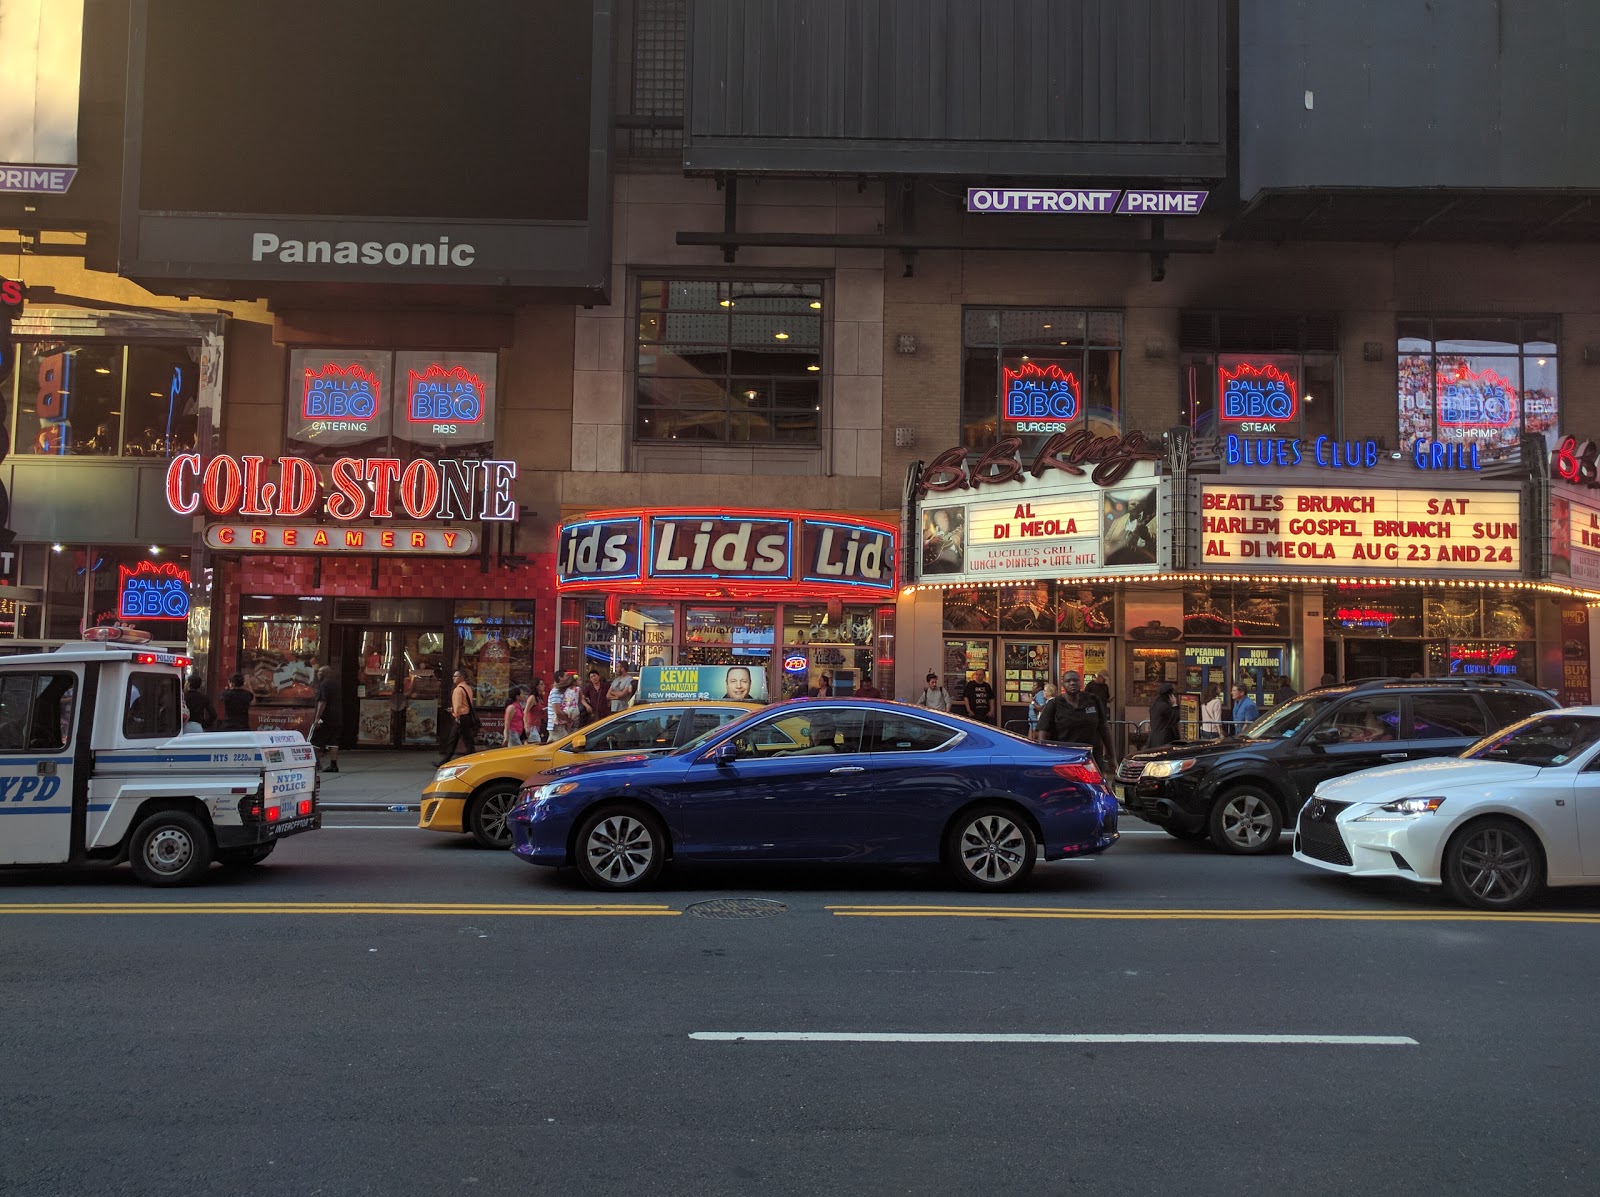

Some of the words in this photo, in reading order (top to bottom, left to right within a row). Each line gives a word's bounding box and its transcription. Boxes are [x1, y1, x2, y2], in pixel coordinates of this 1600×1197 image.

[973, 190, 1112, 210] OUTFRONT
[1128, 193, 1199, 211] PRIME
[252, 232, 475, 267] Panasonic
[314, 379, 369, 391] DALLAS
[418, 382, 473, 393] DALLAS
[1013, 380, 1068, 392] DALLAS
[1229, 380, 1285, 391] DALLAS
[1447, 385, 1504, 396] DALLAS
[307, 391, 375, 418] BBQ
[412, 393, 480, 420] BBQ
[1008, 390, 1076, 417] BBQ
[1224, 390, 1293, 417] BBQ
[1441, 396, 1510, 423] BBQ
[311, 421, 367, 432] CATERING
[433, 424, 457, 434] RIBS
[1016, 421, 1066, 433] BURGERS
[1241, 422, 1276, 432] STEAK
[1455, 429, 1497, 438] SHRIMP
[1031, 429, 1162, 486] King
[1226, 434, 1302, 466] BLUES
[1315, 434, 1378, 468] CLUB
[1415, 437, 1481, 471] GRILL
[165, 453, 317, 516] COLD
[328, 456, 517, 521] STONE
[1014, 503, 1036, 519] AL
[1202, 493, 1284, 512] BEATLES
[1297, 495, 1375, 514] BRUNCH
[1427, 498, 1470, 516] SAT
[994, 523, 1010, 539] DI
[1020, 517, 1077, 537] MEOLA
[1202, 516, 1280, 535] HARLEM
[1289, 518, 1362, 537] GOSPEL
[1373, 520, 1451, 539] BRUNCH
[1473, 522, 1518, 540] SUN
[218, 527, 457, 548] CREAMERY
[655, 521, 786, 571] Lids
[988, 547, 1040, 559] LUCILLE'S
[1043, 545, 1076, 555] GRILL
[1206, 540, 1231, 557] AL
[1241, 540, 1261, 558] DI
[1266, 542, 1336, 559] MEOLA
[1352, 543, 1399, 561] AUG
[1407, 544, 1431, 561] 23
[1437, 545, 1480, 562] AND
[1485, 545, 1513, 563] 24
[970, 559, 997, 570] LUNCH
[1005, 557, 1040, 569] DINNER
[1050, 555, 1072, 567] LATE
[1075, 553, 1096, 565] NITE
[128, 578, 182, 591] DALLAS
[121, 590, 190, 617] BBQ
[647, 631, 664, 641] THIS
[157, 654, 176, 662] POLICE
[1185, 647, 1225, 657] APPEARING
[1250, 649, 1268, 658] NOW
[785, 659, 807, 668] OPEN
[1196, 657, 1214, 665] NEXT
[1240, 658, 1279, 667] APPEARING
[660, 670, 699, 683] KEVIN
[1565, 665, 1587, 675] BUY
[660, 683, 676, 691] CAN
[678, 683, 697, 691] WAIT
[1565, 680, 1588, 688] HERE
[276, 772, 303, 784] NYPD
[272, 781, 306, 794] POLICE
